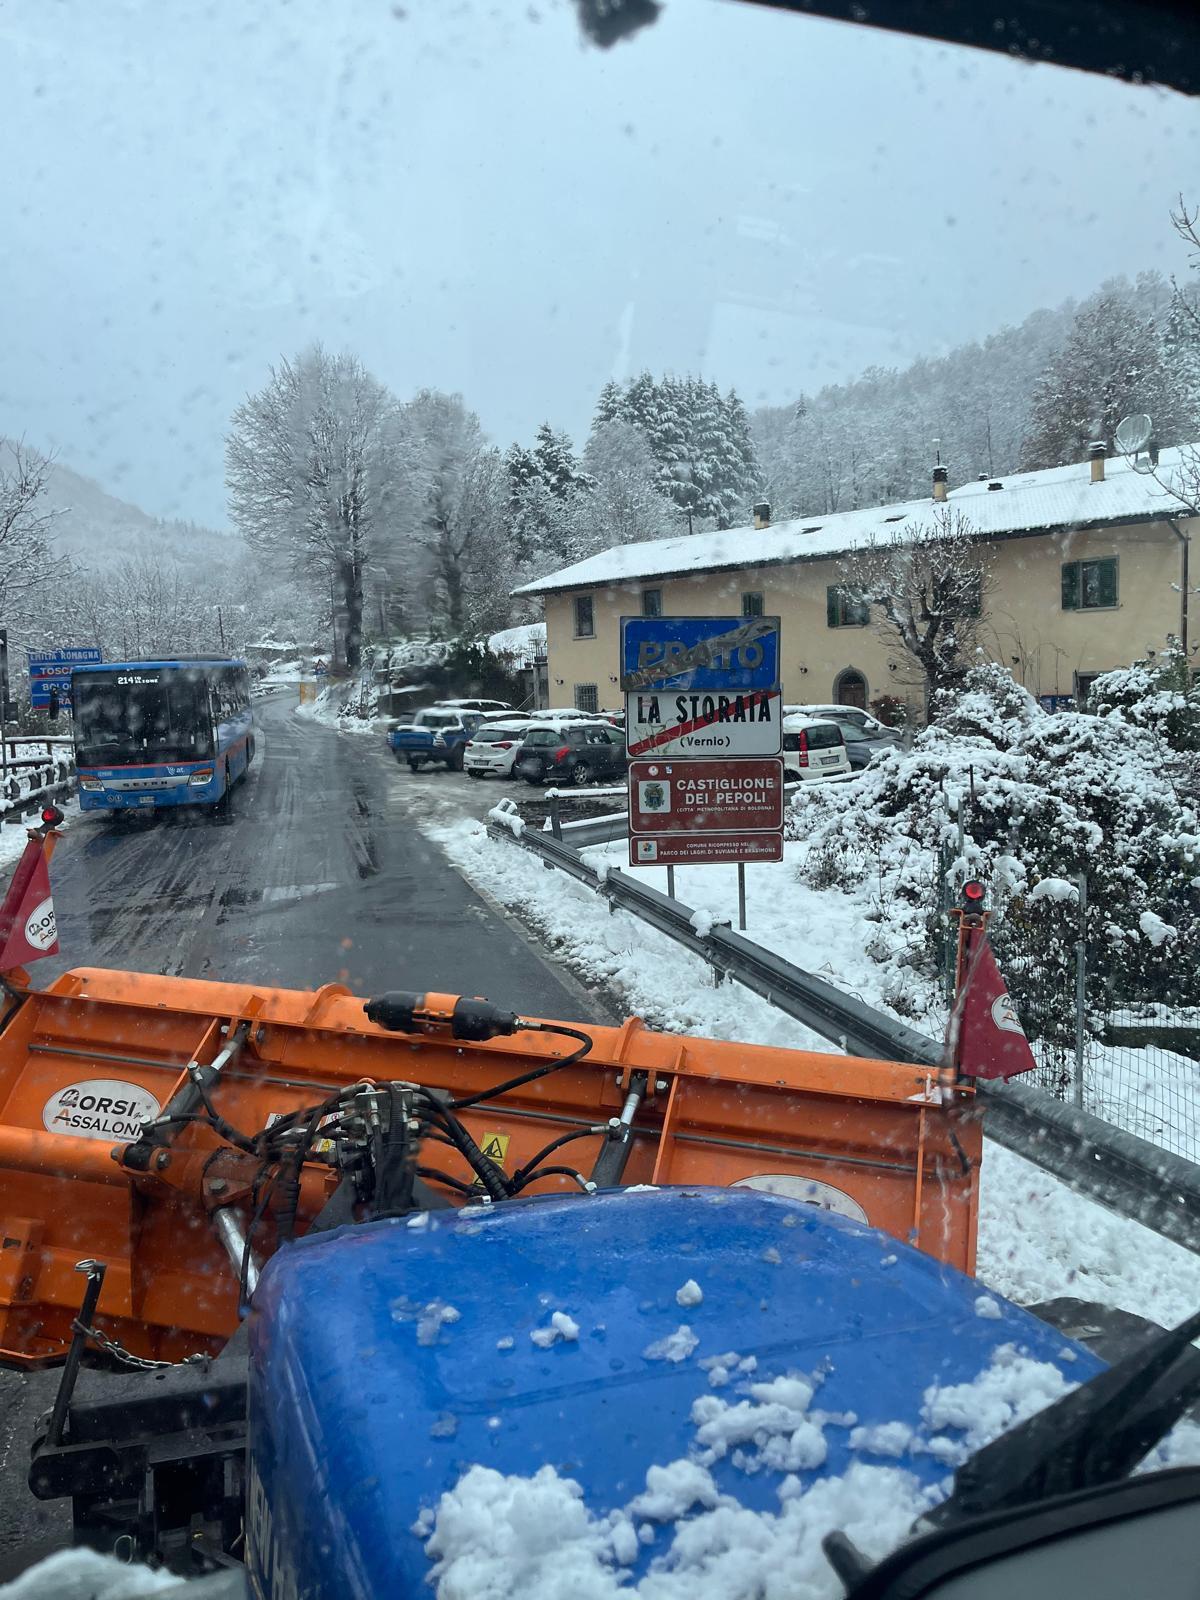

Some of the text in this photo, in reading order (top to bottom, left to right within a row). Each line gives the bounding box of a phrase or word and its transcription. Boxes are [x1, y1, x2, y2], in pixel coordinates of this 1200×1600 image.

[60, 651, 99, 660] ROMAGNA
[638, 641, 763, 669] PRATO
[117, 676, 134, 685] 214
[637, 695, 772, 723] LA STORAIA
[680, 736, 731, 748] (Vernio)
[676, 778, 775, 791] CASTIGLIONE
[685, 792, 766, 805] DEI PEPOLI
